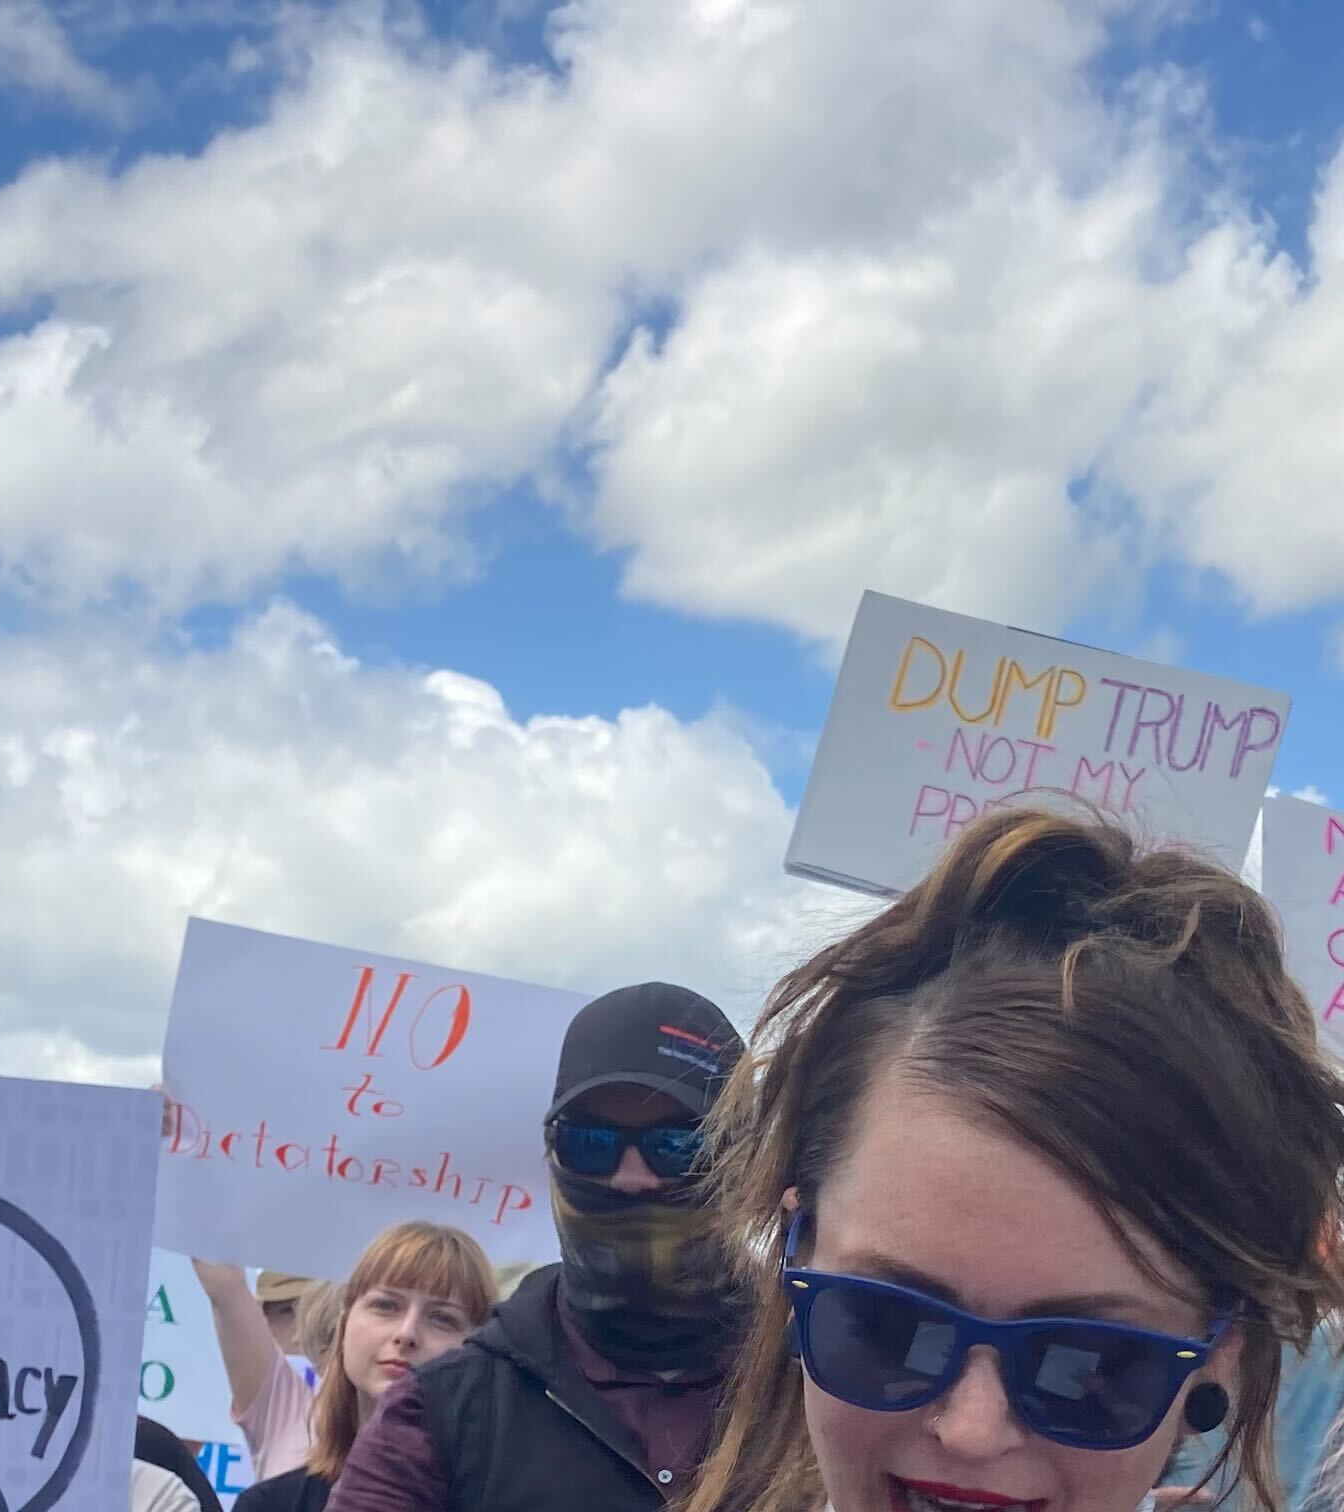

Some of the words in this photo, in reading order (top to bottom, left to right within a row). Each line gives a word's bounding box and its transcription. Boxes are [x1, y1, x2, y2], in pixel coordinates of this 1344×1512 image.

[887, 635, 1087, 740] DUMP
[1099, 677, 1281, 779] TRUMP
[944, 727, 1055, 790] NOT
[1071, 756, 1146, 812] MY
[319, 966, 471, 1070] NO
[341, 1073, 405, 1118] to
